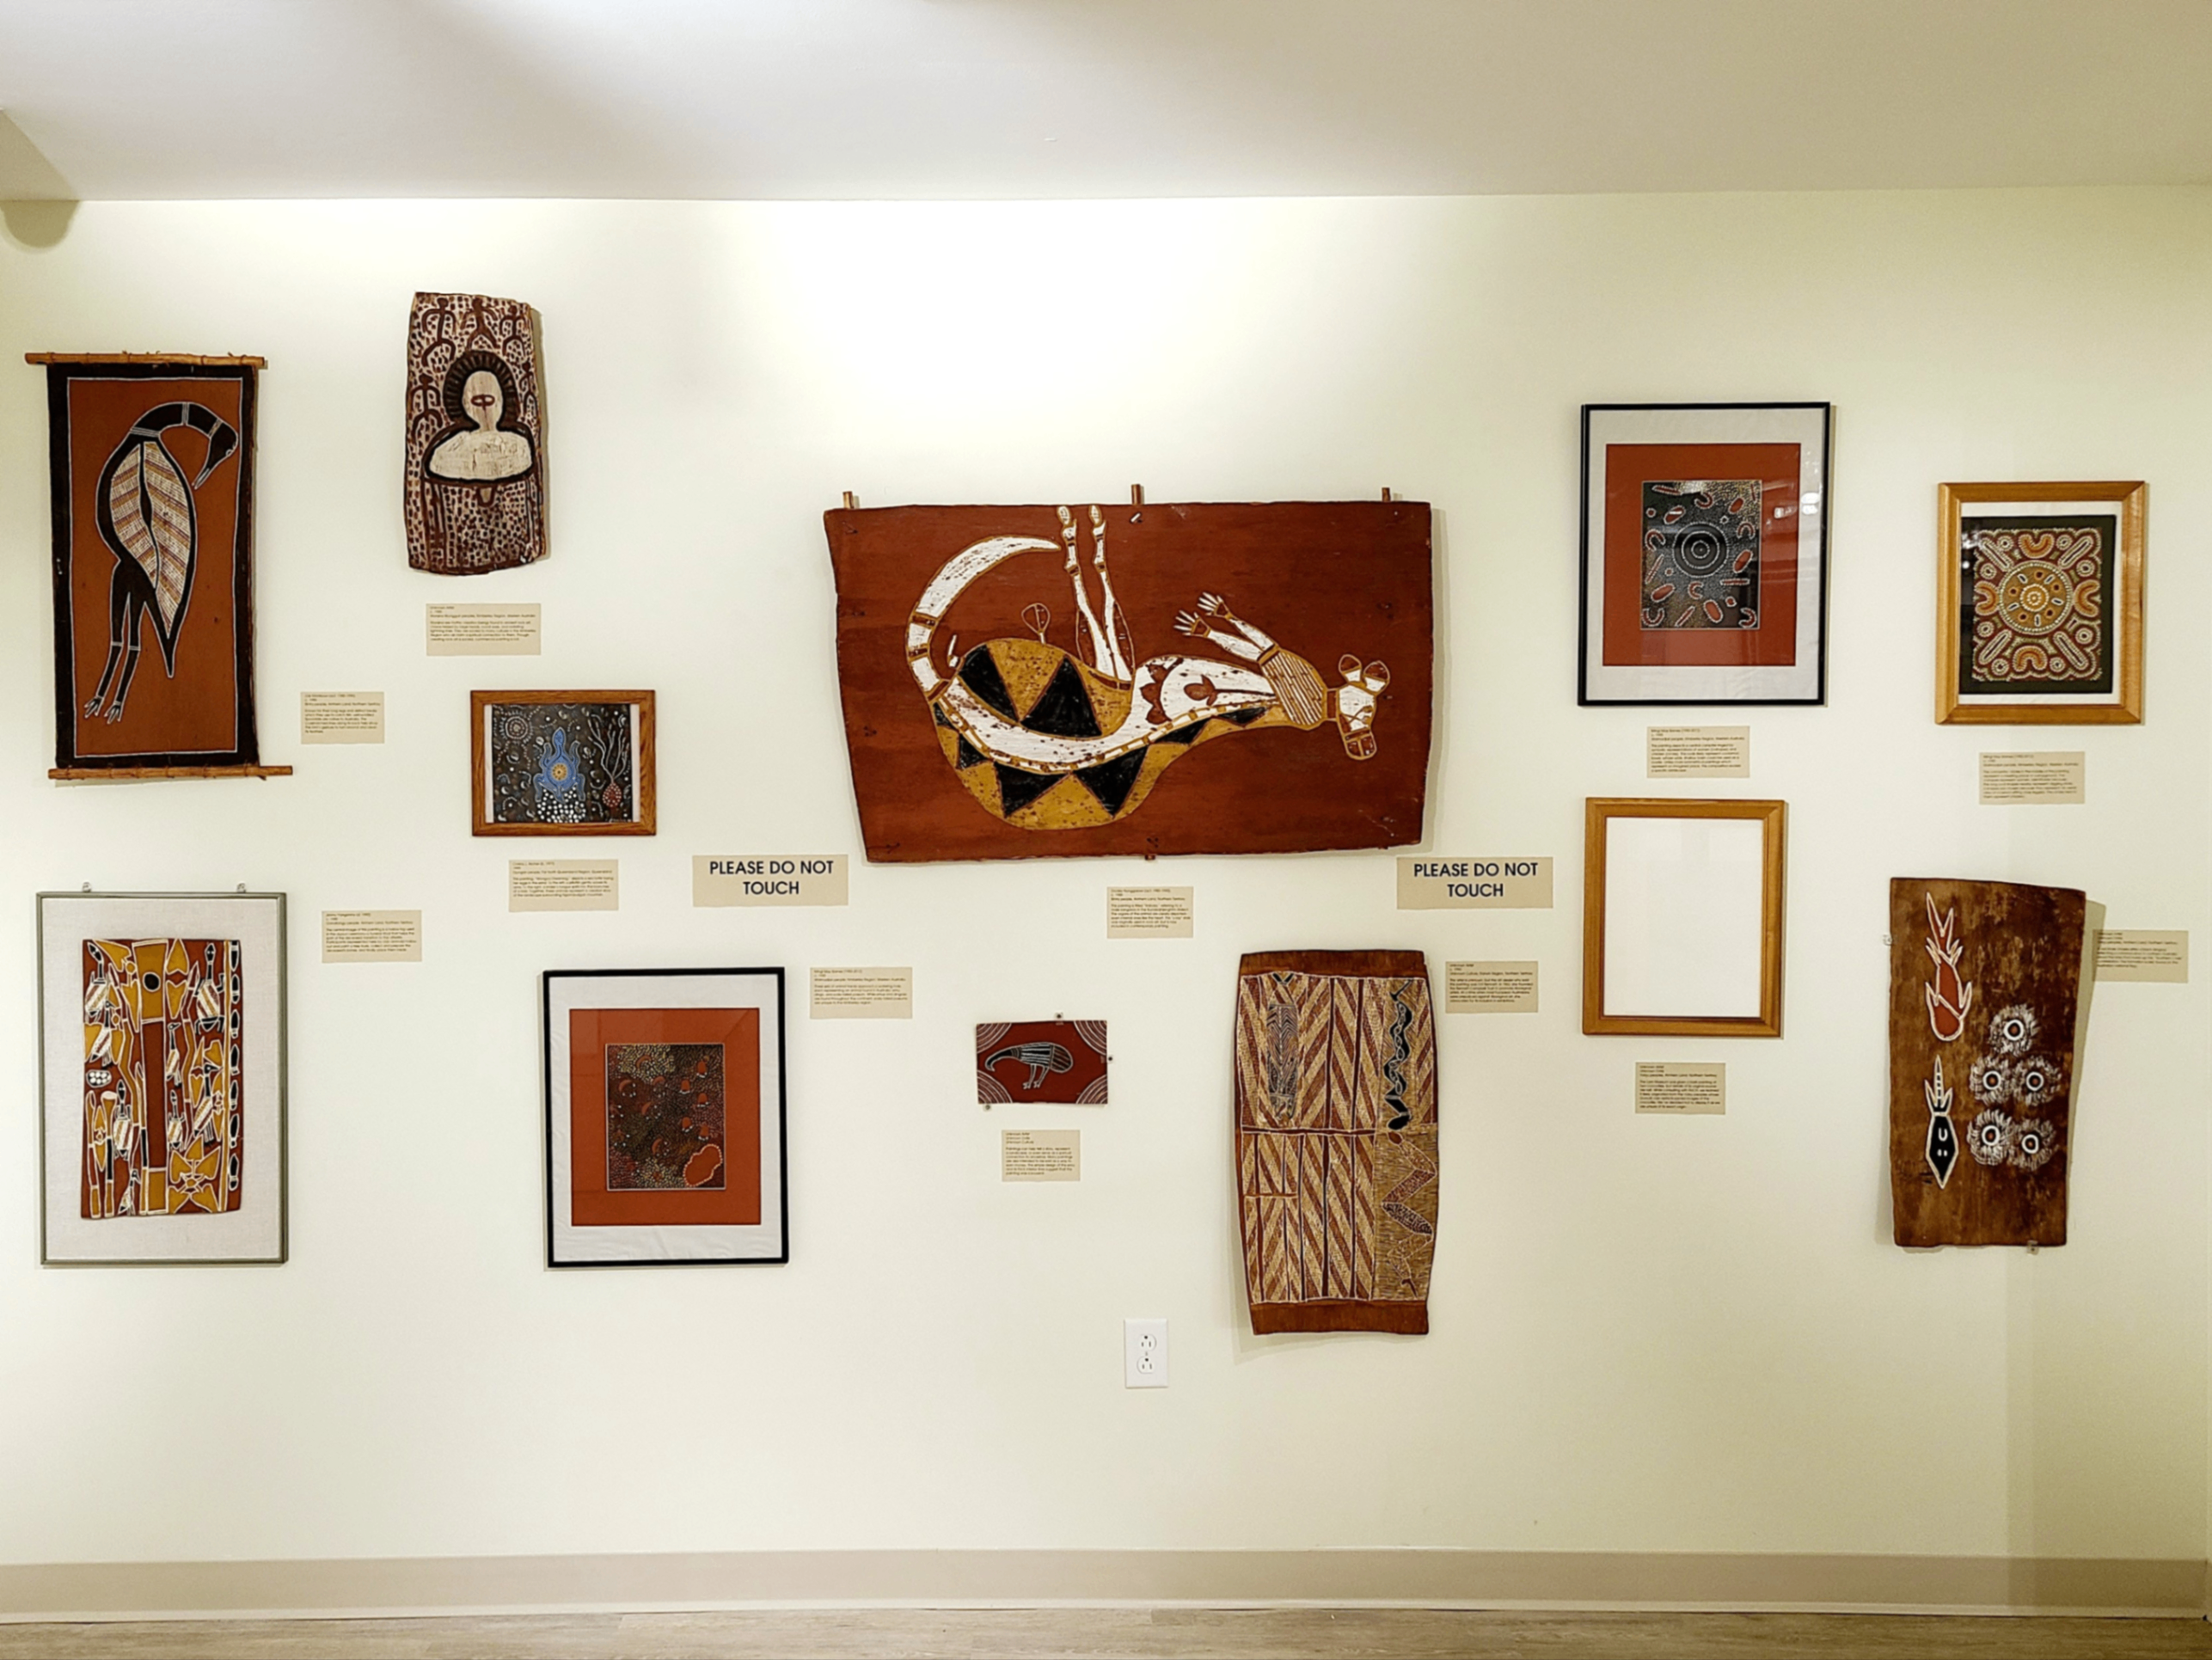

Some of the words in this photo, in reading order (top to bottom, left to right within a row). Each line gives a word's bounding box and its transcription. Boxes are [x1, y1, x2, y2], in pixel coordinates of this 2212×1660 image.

[709, 861, 764, 875] PLEASE
[769, 860, 795, 875] DO
[800, 860, 834, 874] NOT
[1413, 862, 1469, 878] PLEASE
[1474, 862, 1500, 877] DO
[1504, 861, 1539, 877] NOT
[742, 880, 800, 895] TOUCH
[1446, 883, 1504, 897] TOUCH
